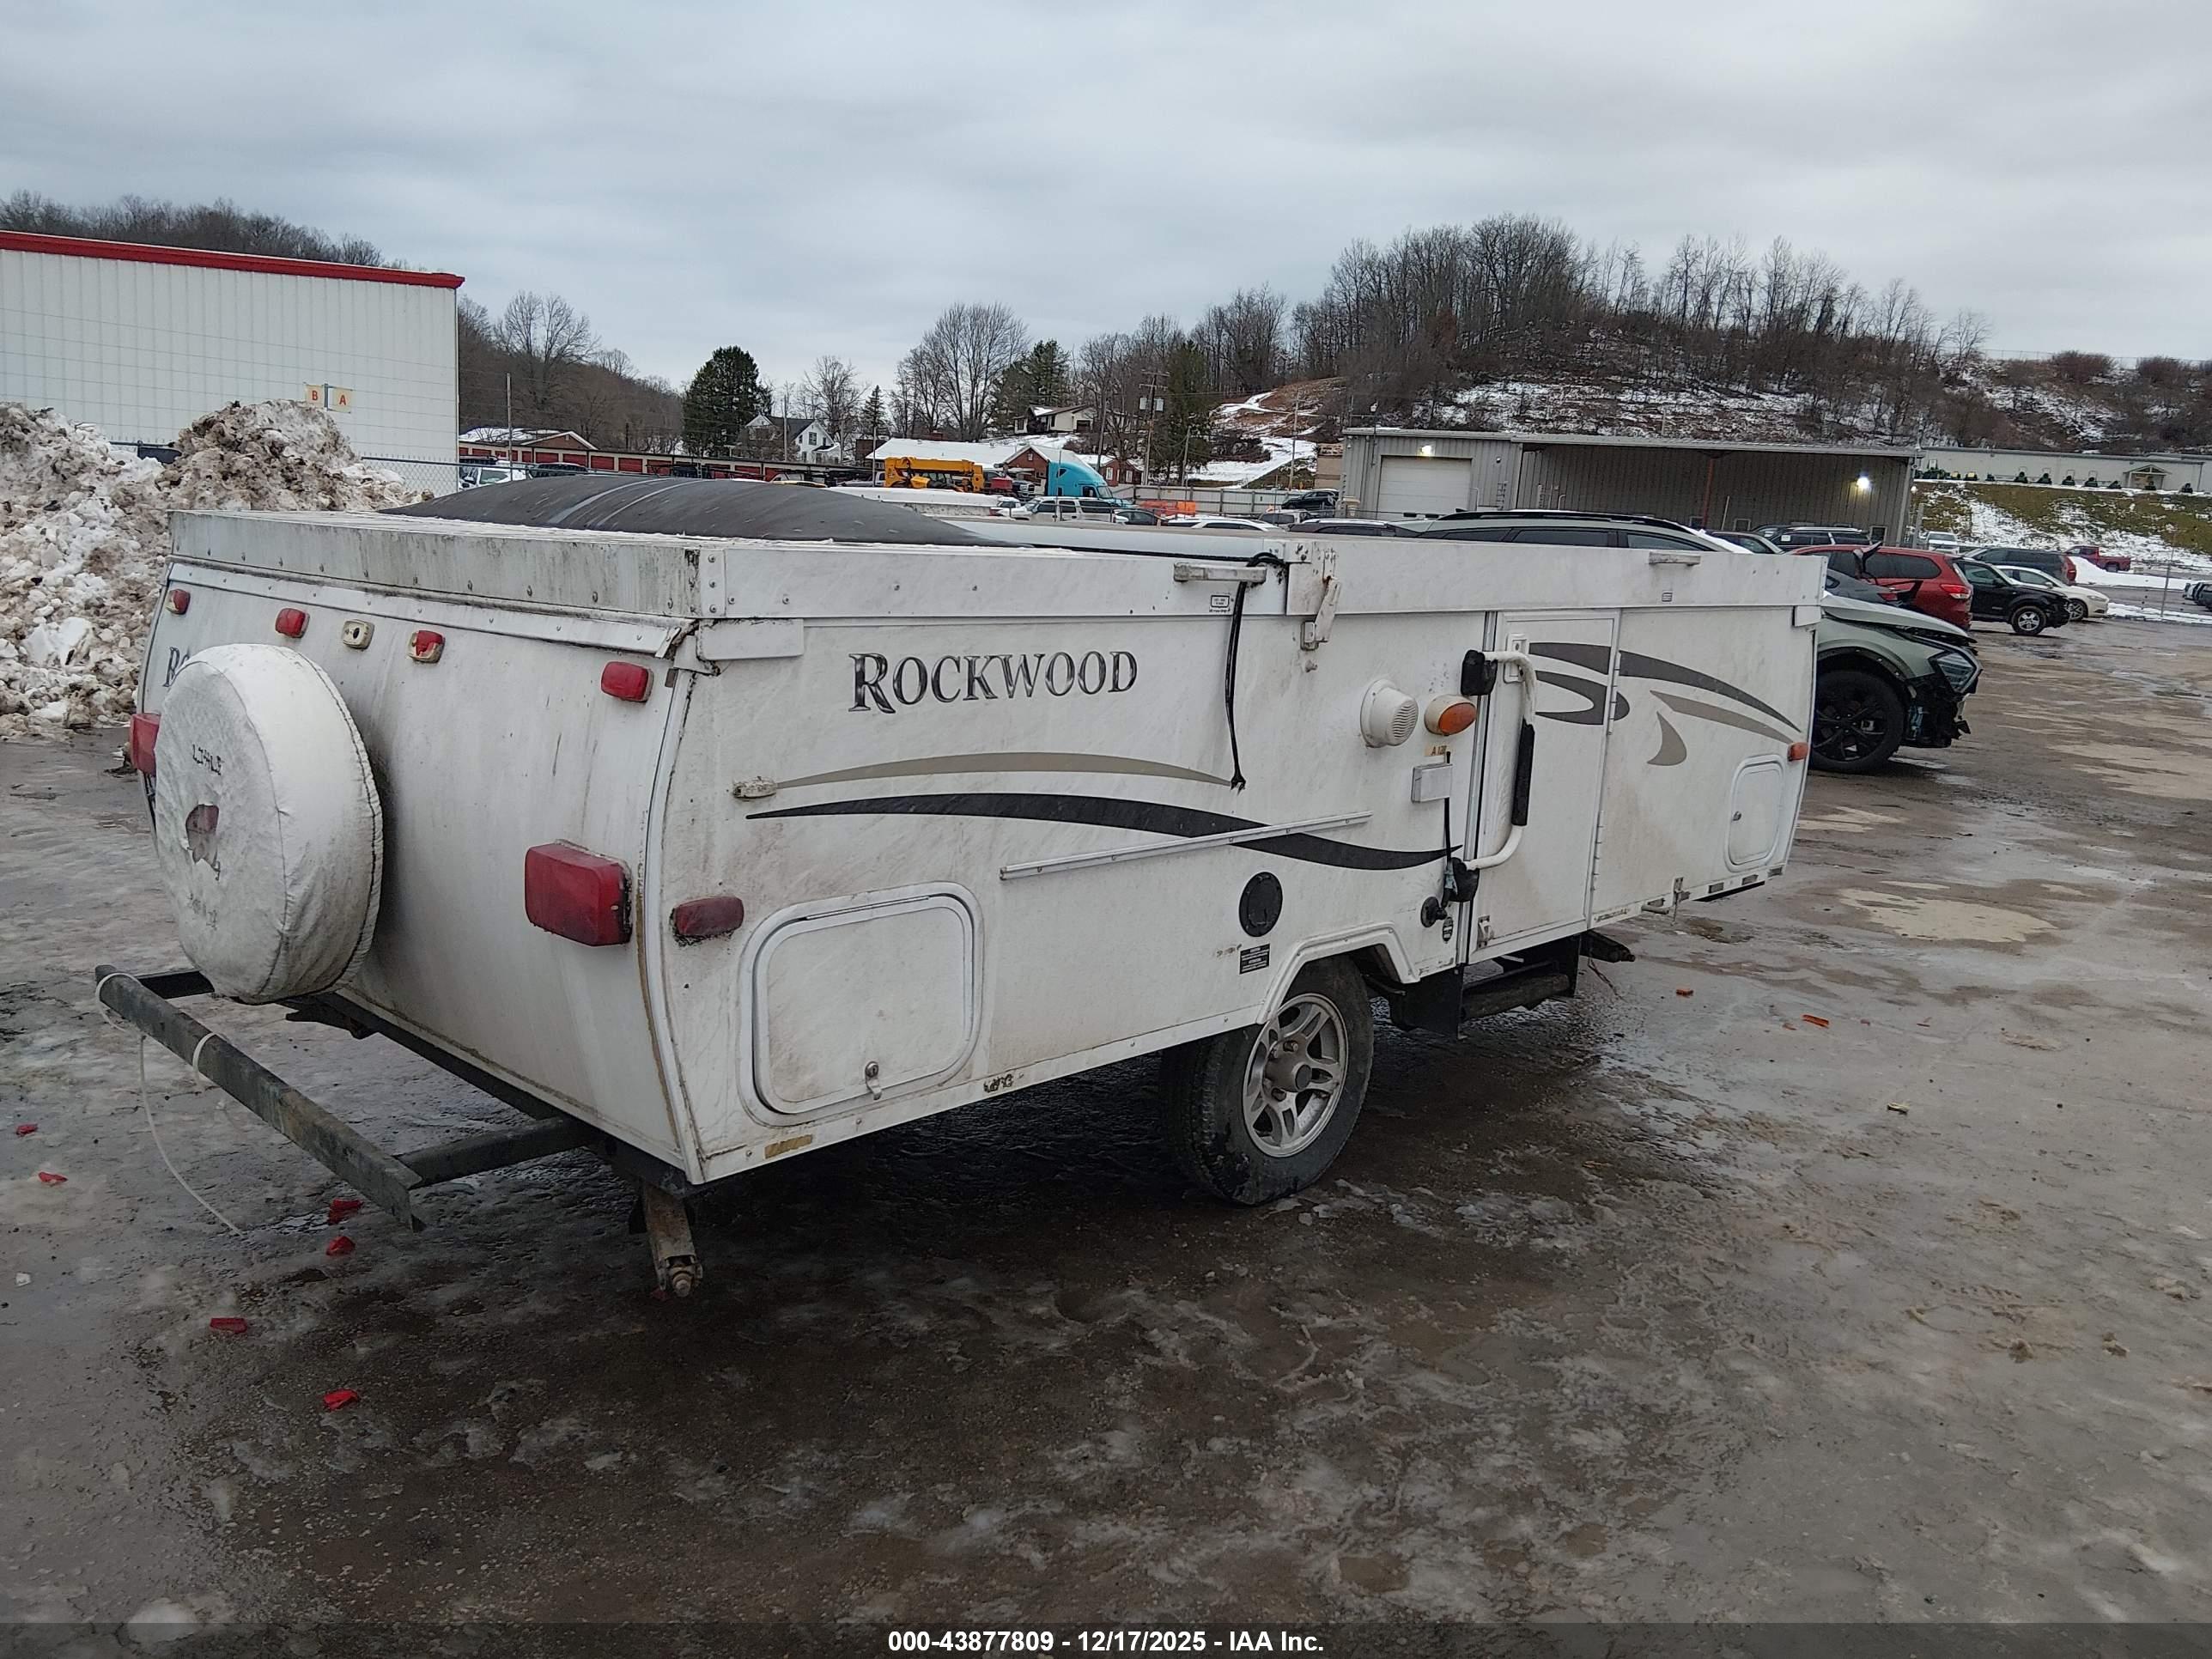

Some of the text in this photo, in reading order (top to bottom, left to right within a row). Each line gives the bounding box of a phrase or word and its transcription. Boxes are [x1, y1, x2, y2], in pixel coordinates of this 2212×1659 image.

[312, 390, 318, 401] B
[338, 394, 346, 405] A
[848, 650, 1138, 714] ROCKWOOD
